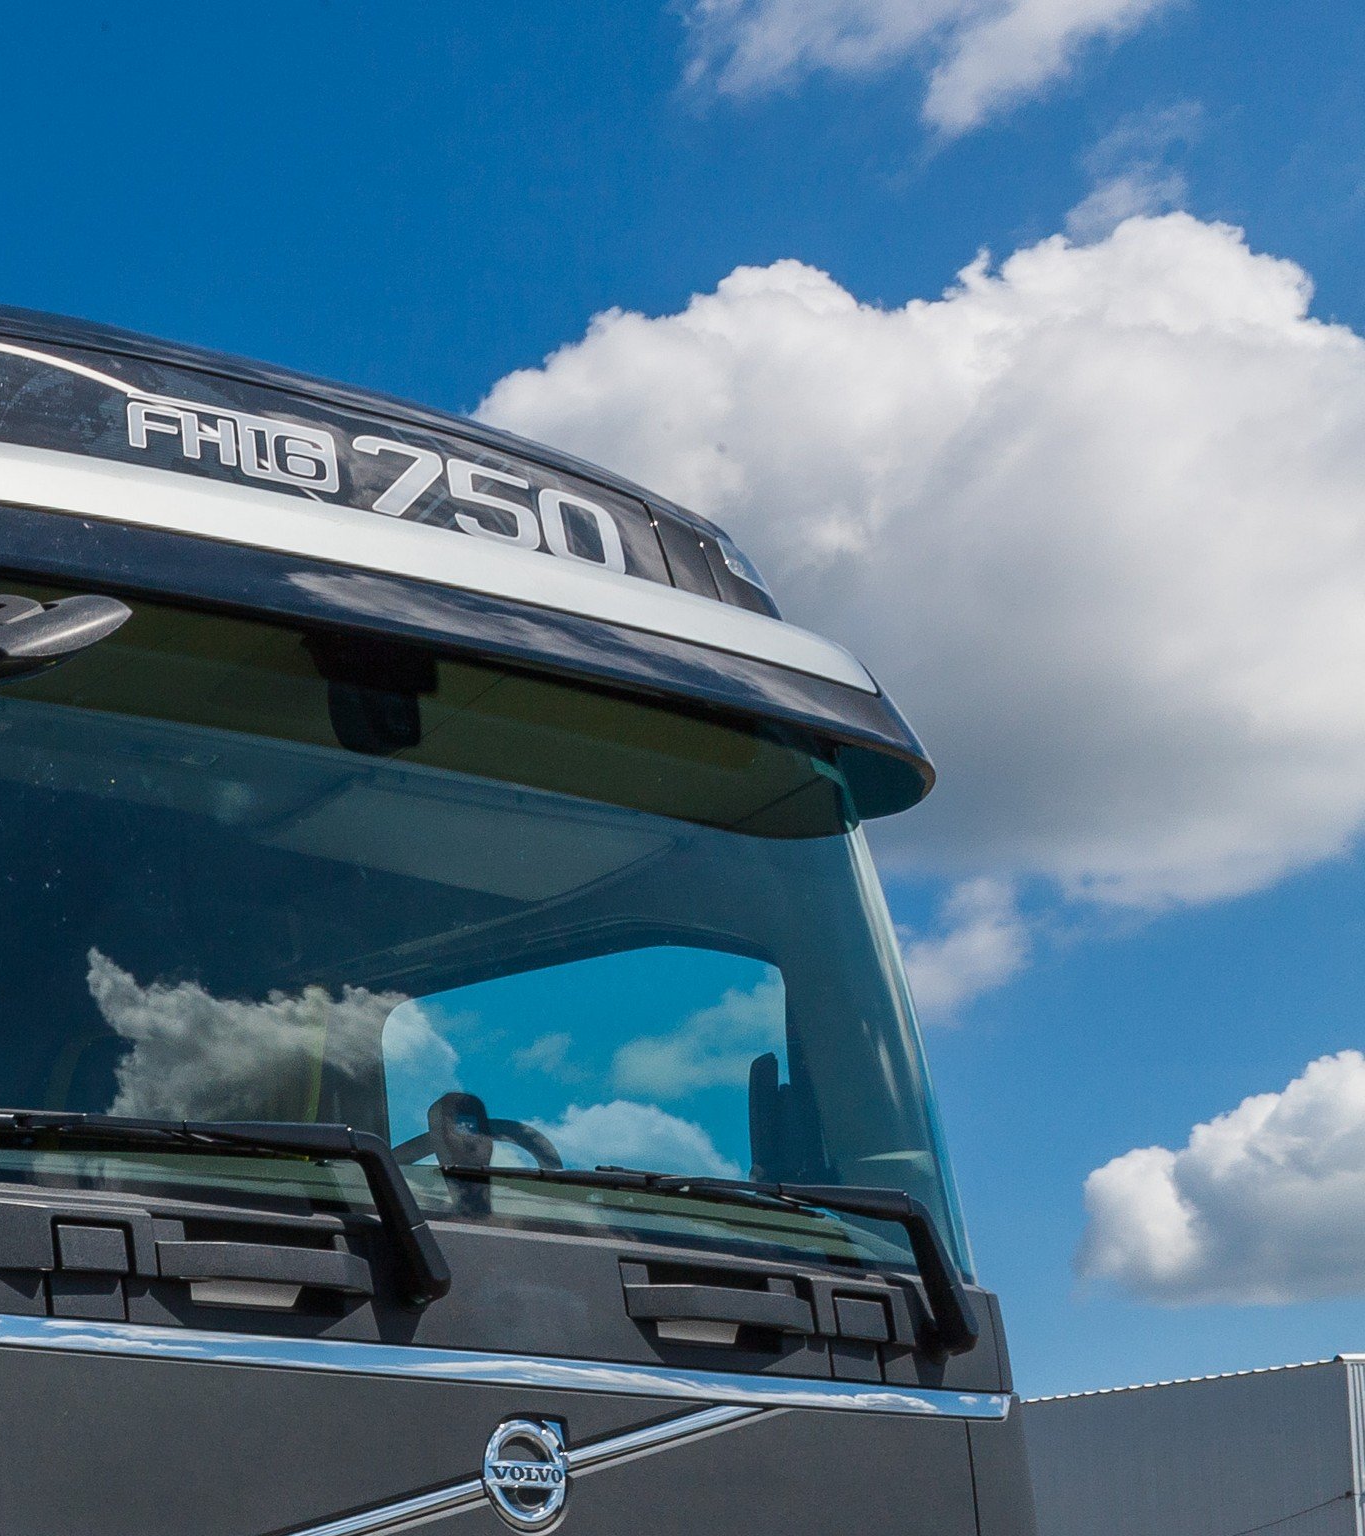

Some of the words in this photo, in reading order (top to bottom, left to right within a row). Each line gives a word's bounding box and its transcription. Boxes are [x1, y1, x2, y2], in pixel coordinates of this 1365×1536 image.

[127, 397, 340, 493] FH16
[352, 435, 626, 575] 750
[489, 1465, 563, 1484] VOLVO
